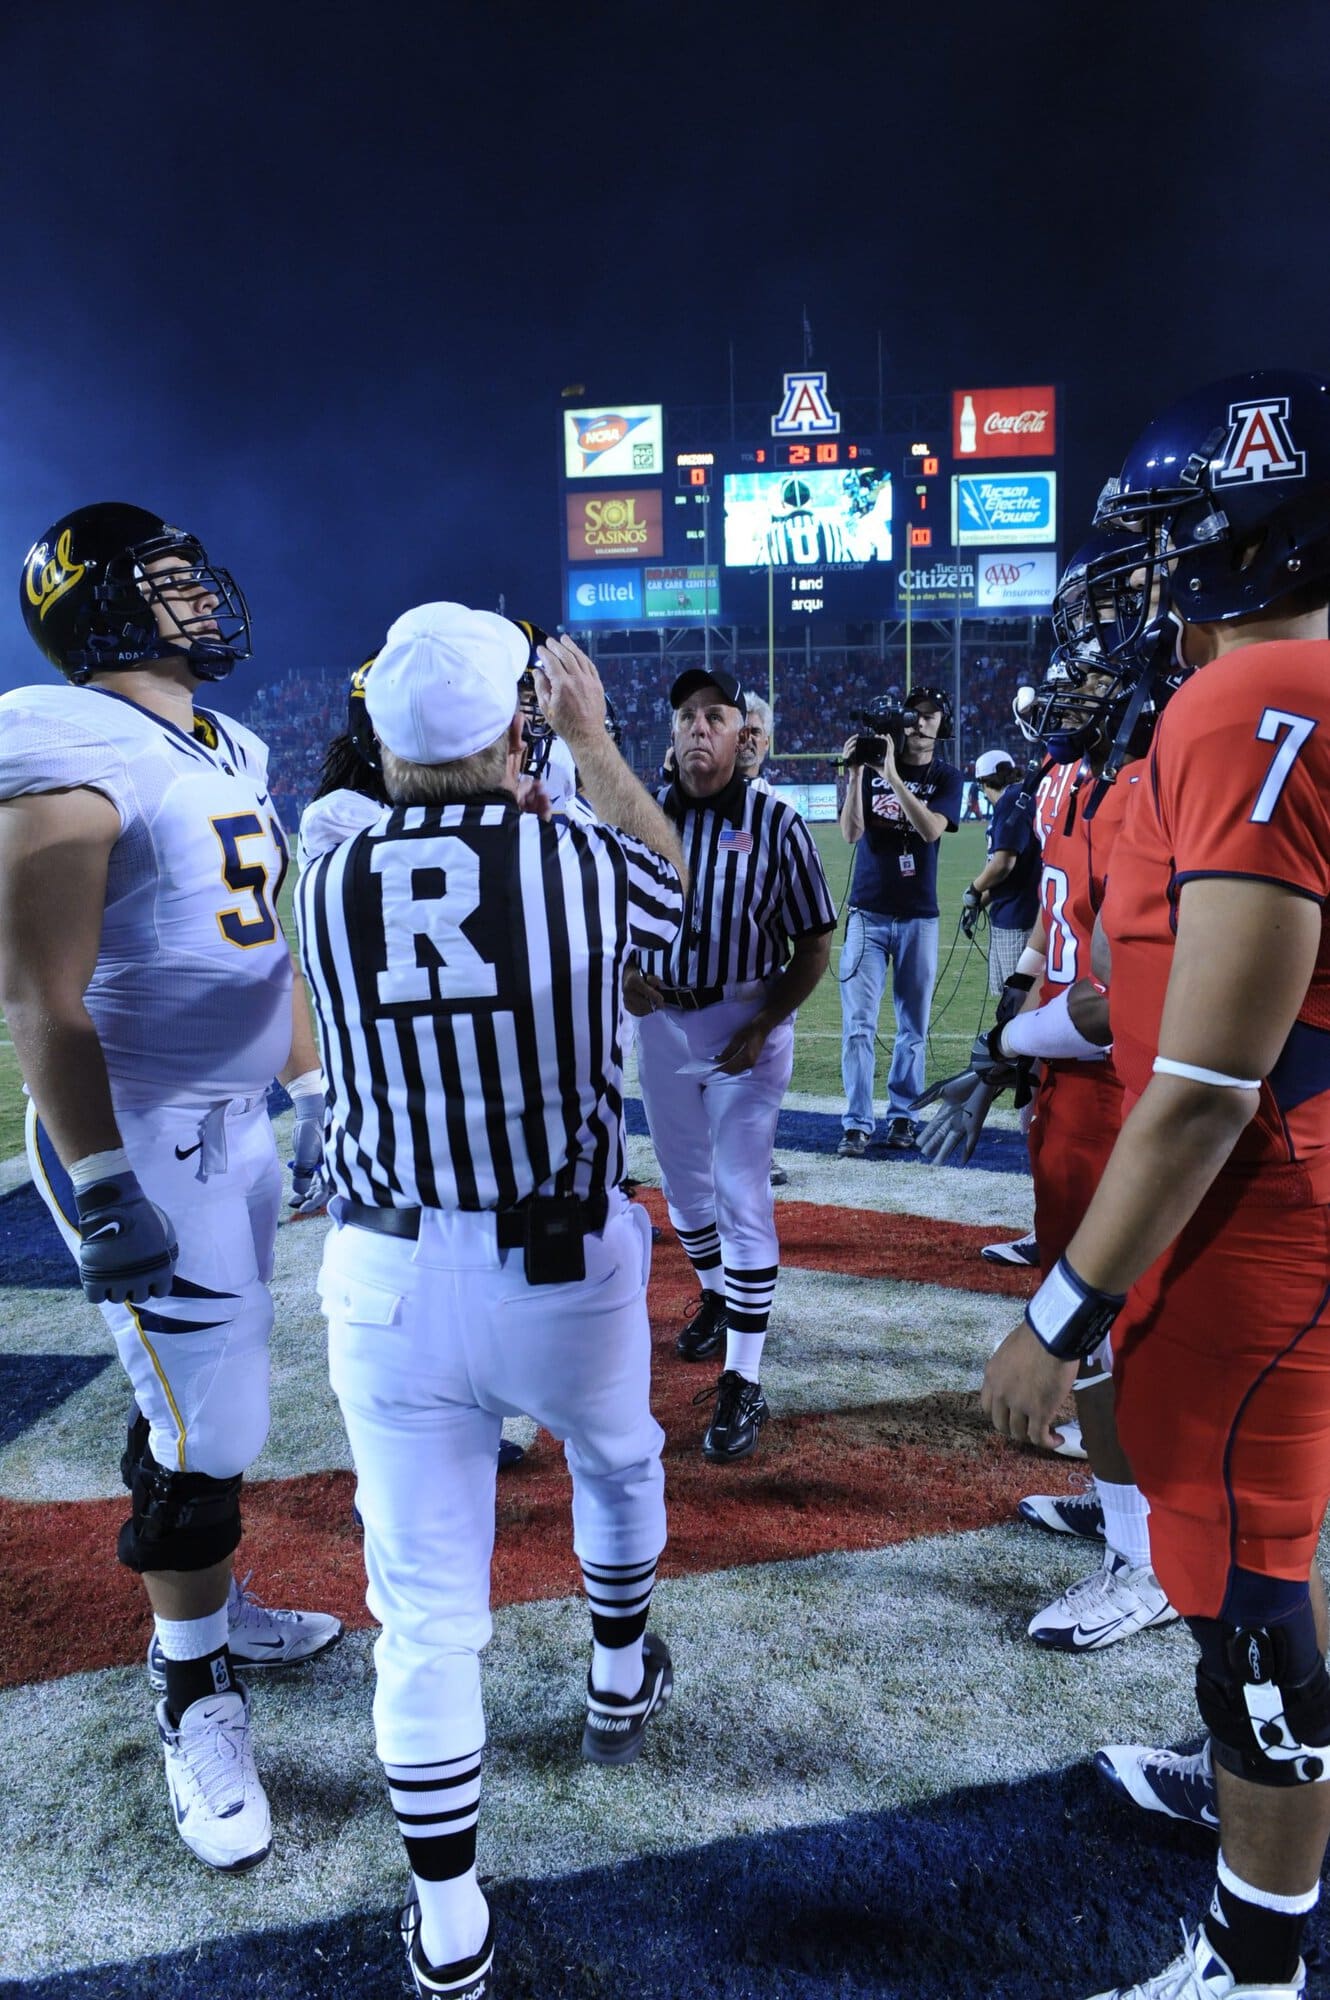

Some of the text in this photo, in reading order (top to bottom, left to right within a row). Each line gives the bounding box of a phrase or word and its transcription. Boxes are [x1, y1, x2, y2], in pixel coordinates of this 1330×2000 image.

[771, 371, 841, 437] A
[983, 410, 1049, 435] Coca-Cola
[1212, 396, 1307, 489] A
[979, 484, 1029, 499] Tucson
[984, 496, 1042, 511] Electric
[584, 498, 647, 532] SOL
[990, 510, 1042, 524] Power
[584, 529, 648, 546] CASINOS
[25, 529, 86, 621] Cal
[898, 568, 975, 590] Citizen
[935, 563, 973, 574] Tucson
[646, 581, 663, 591] CAR
[664, 580, 684, 590] CARE
[799, 576, 824, 591] and
[1249, 707, 1318, 824] 7
[369, 835, 498, 1005] R
